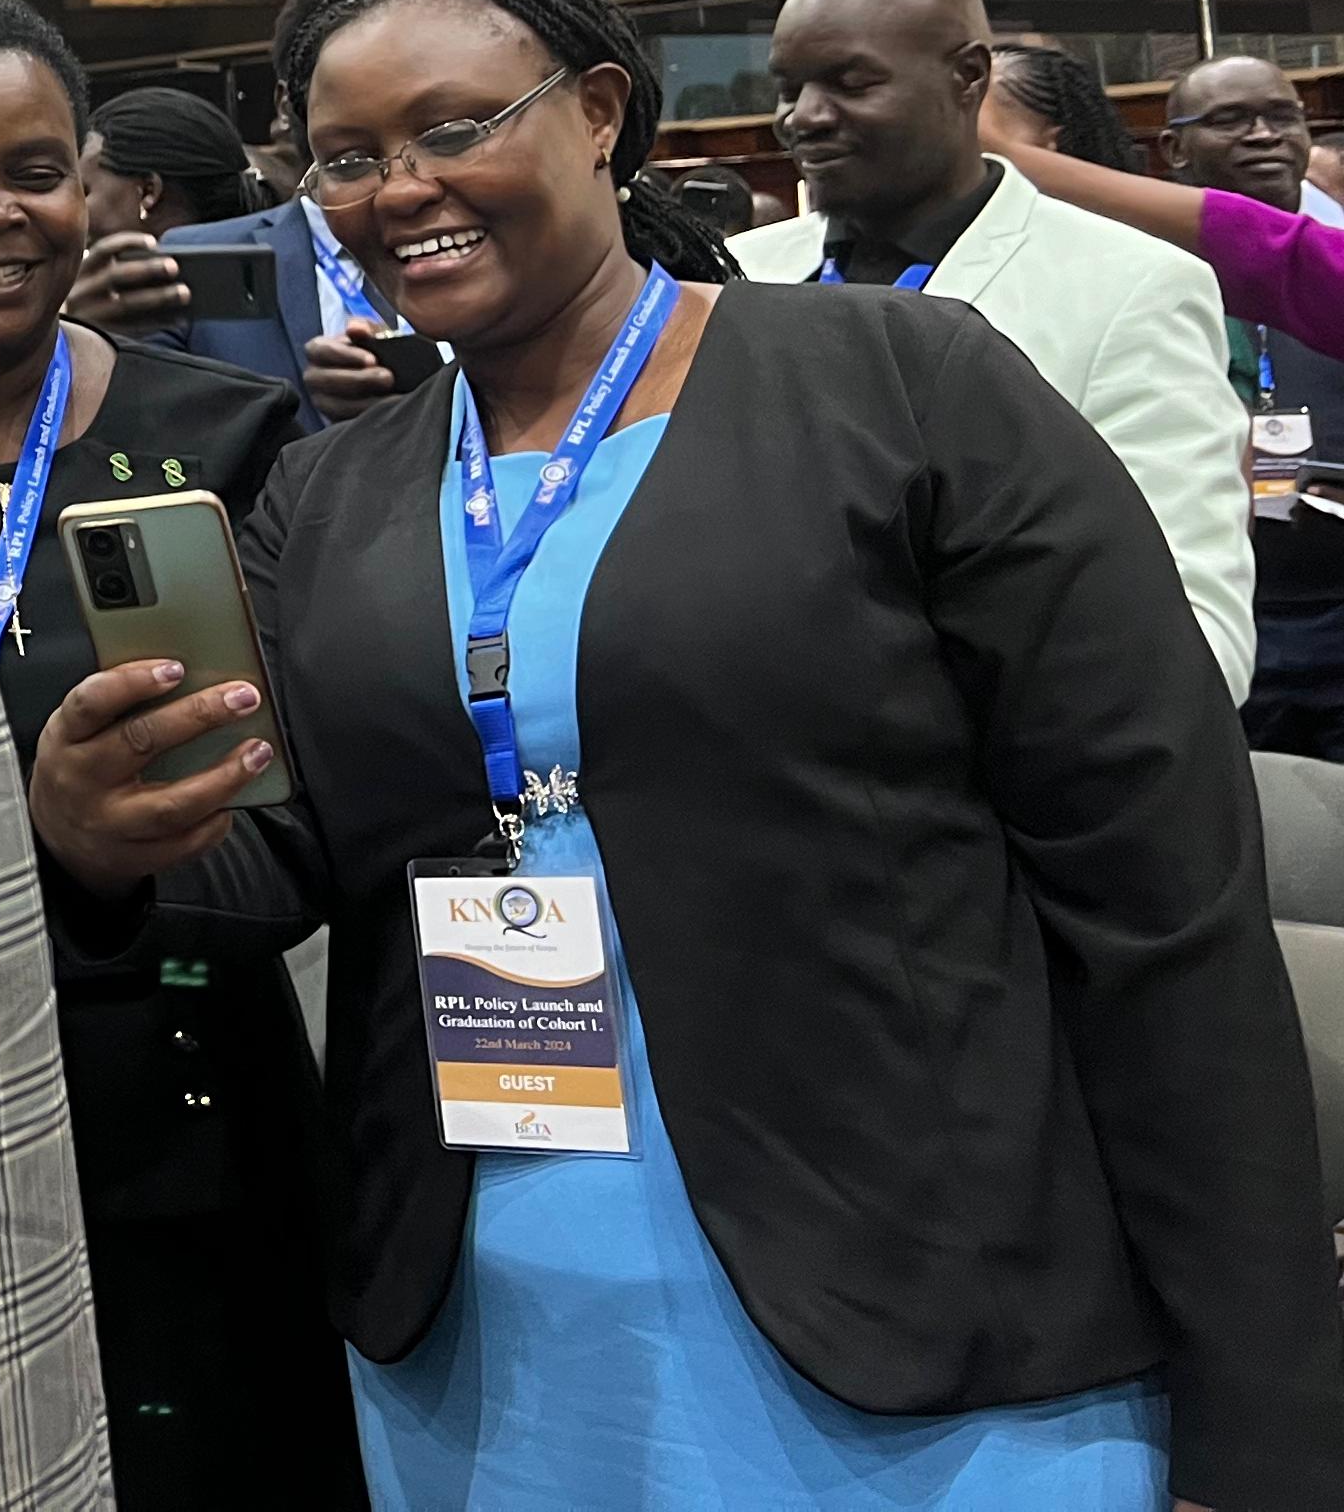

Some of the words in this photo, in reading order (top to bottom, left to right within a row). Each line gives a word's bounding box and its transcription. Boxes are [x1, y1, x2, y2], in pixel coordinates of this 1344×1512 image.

[567, 418, 593, 446] RPL
[583, 384, 612, 416] Policy
[16, 488, 39, 524] Policy
[10, 527, 27, 558] RPL
[448, 885, 567, 939] KNQA
[434, 995, 470, 1010] RPL
[475, 997, 517, 1013] Policy
[522, 998, 574, 1012] Launch
[577, 999, 603, 1013] and
[438, 1015, 515, 1029] Graduation
[518, 1016, 535, 1029] of
[536, 1017, 586, 1031] Cohort
[474, 1037, 503, 1049] 22nd
[504, 1039, 541, 1050] March
[544, 1039, 572, 1051] 2024
[499, 1074, 556, 1092] GUEST
